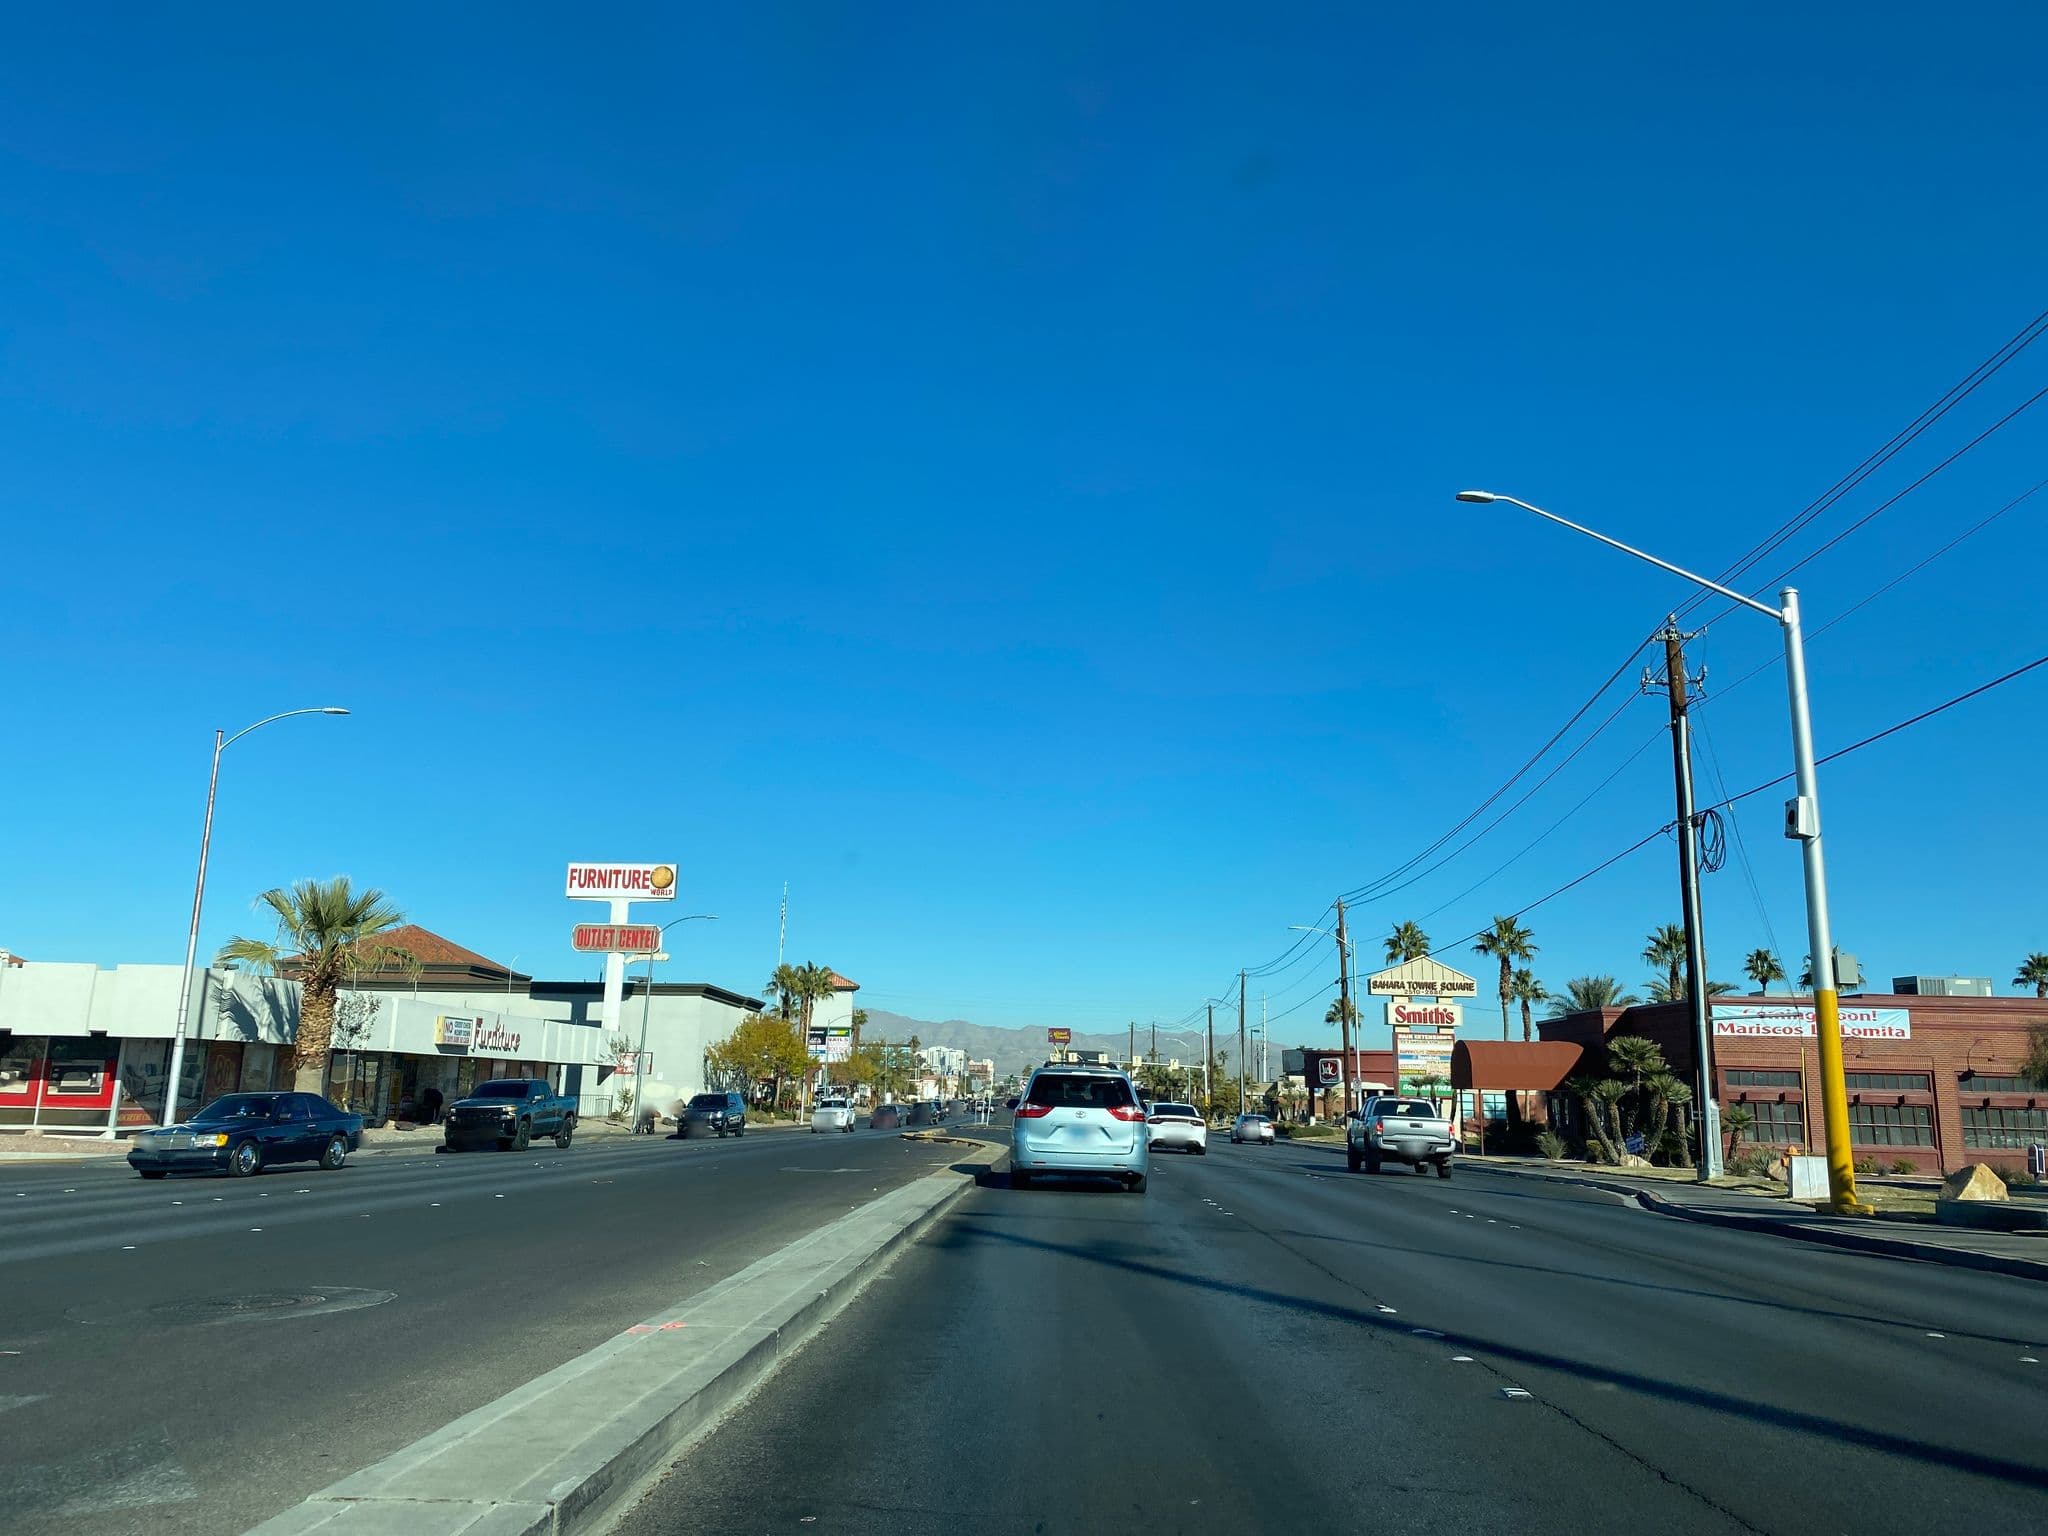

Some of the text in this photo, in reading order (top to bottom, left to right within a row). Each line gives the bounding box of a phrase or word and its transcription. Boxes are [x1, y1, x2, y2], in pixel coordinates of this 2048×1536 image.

[569, 868, 650, 889] FURNITURE
[650, 888, 672, 896] WORLD
[576, 928, 658, 949] OUTLET CENTER
[1372, 980, 1474, 991] SAHARA TOWNE SQUARE
[1395, 1005, 1455, 1024] Smith's
[1838, 1010, 1877, 1021] oon!
[474, 1015, 520, 1051] Furniture
[1717, 1022, 1803, 1034] Mariscos
[1841, 1025, 1906, 1037] Lomita
